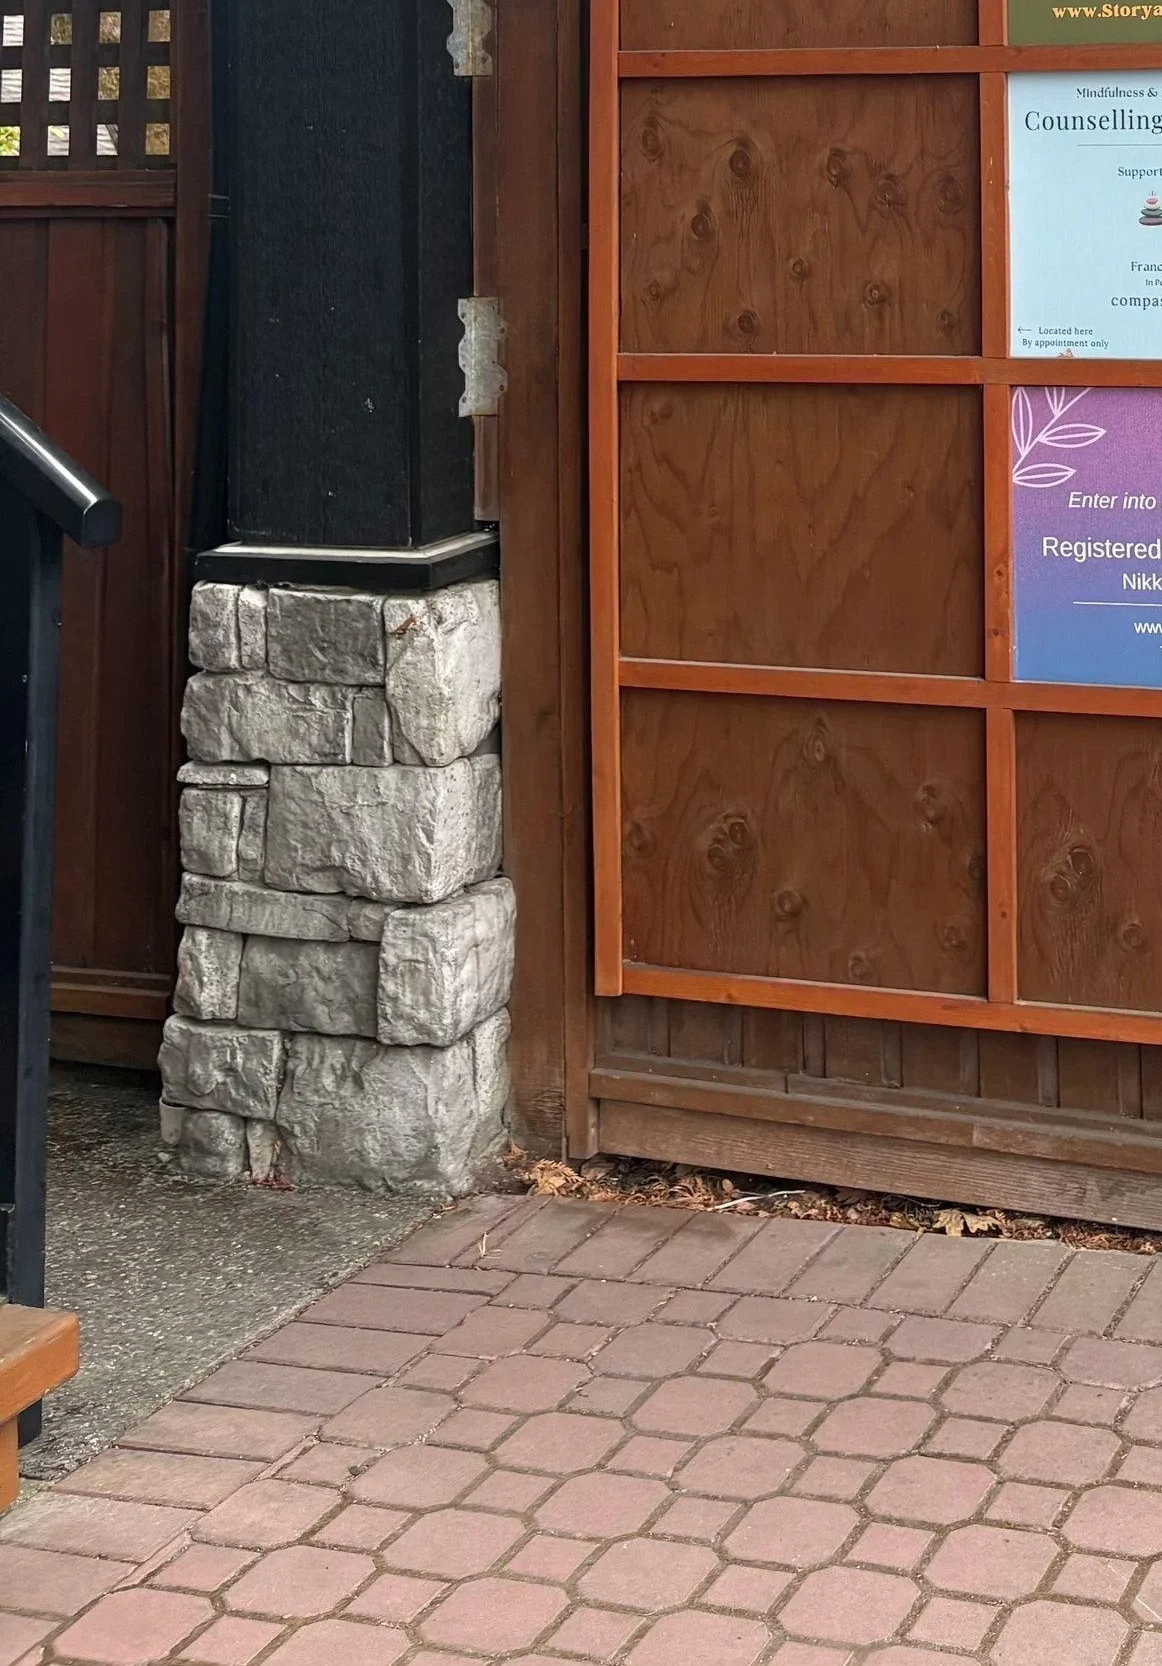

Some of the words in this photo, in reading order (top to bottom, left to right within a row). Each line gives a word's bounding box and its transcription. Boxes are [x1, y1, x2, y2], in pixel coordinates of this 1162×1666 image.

[1077, 87, 1144, 98] Mindfulness
[1147, 87, 1158, 97] &
[1146, 279, 1153, 287] In
[1039, 327, 1071, 335] Located
[1074, 327, 1093, 335] here
[1023, 339, 1034, 349] By
[1035, 340, 1088, 349] appointment
[1091, 340, 1109, 350] only
[1068, 492, 1118, 509] Enter
[1123, 493, 1157, 509] into
[1042, 537, 1162, 562] Registered
